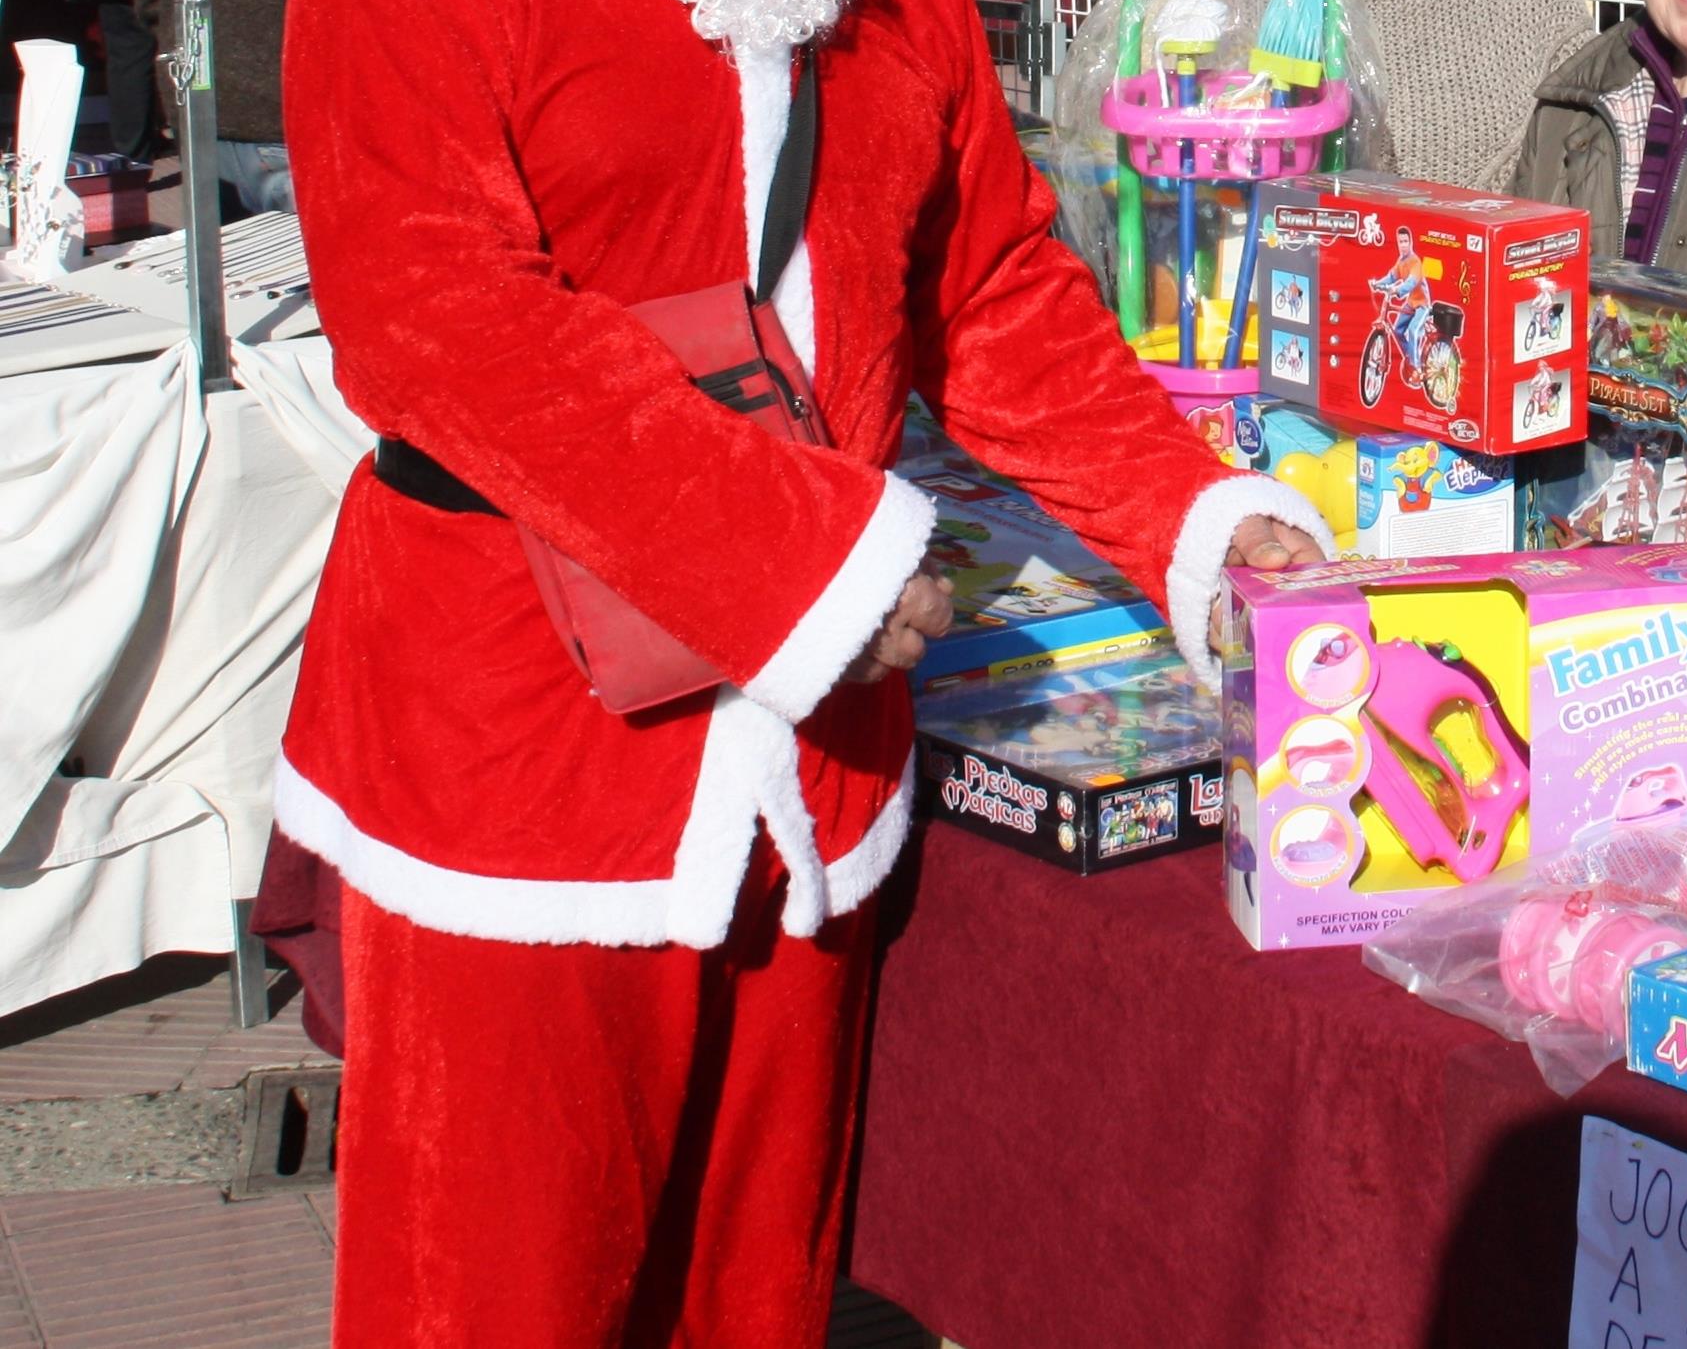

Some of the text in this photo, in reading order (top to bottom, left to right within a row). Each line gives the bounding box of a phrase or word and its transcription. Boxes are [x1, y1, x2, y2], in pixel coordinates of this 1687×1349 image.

[1278, 210, 1356, 232] Street Bicycle
[1589, 377, 1667, 413] PIRATE SET
[1632, 719, 1654, 732] the
[1656, 712, 1680, 725] real
[963, 754, 1048, 812] Piedras
[941, 776, 1037, 834] Mágicas
[1296, 911, 1378, 927] SPECIFICTION
[1321, 924, 1350, 936] MAY
[1350, 922, 1380, 934] VARY
[1609, 1247, 1643, 1315] A
